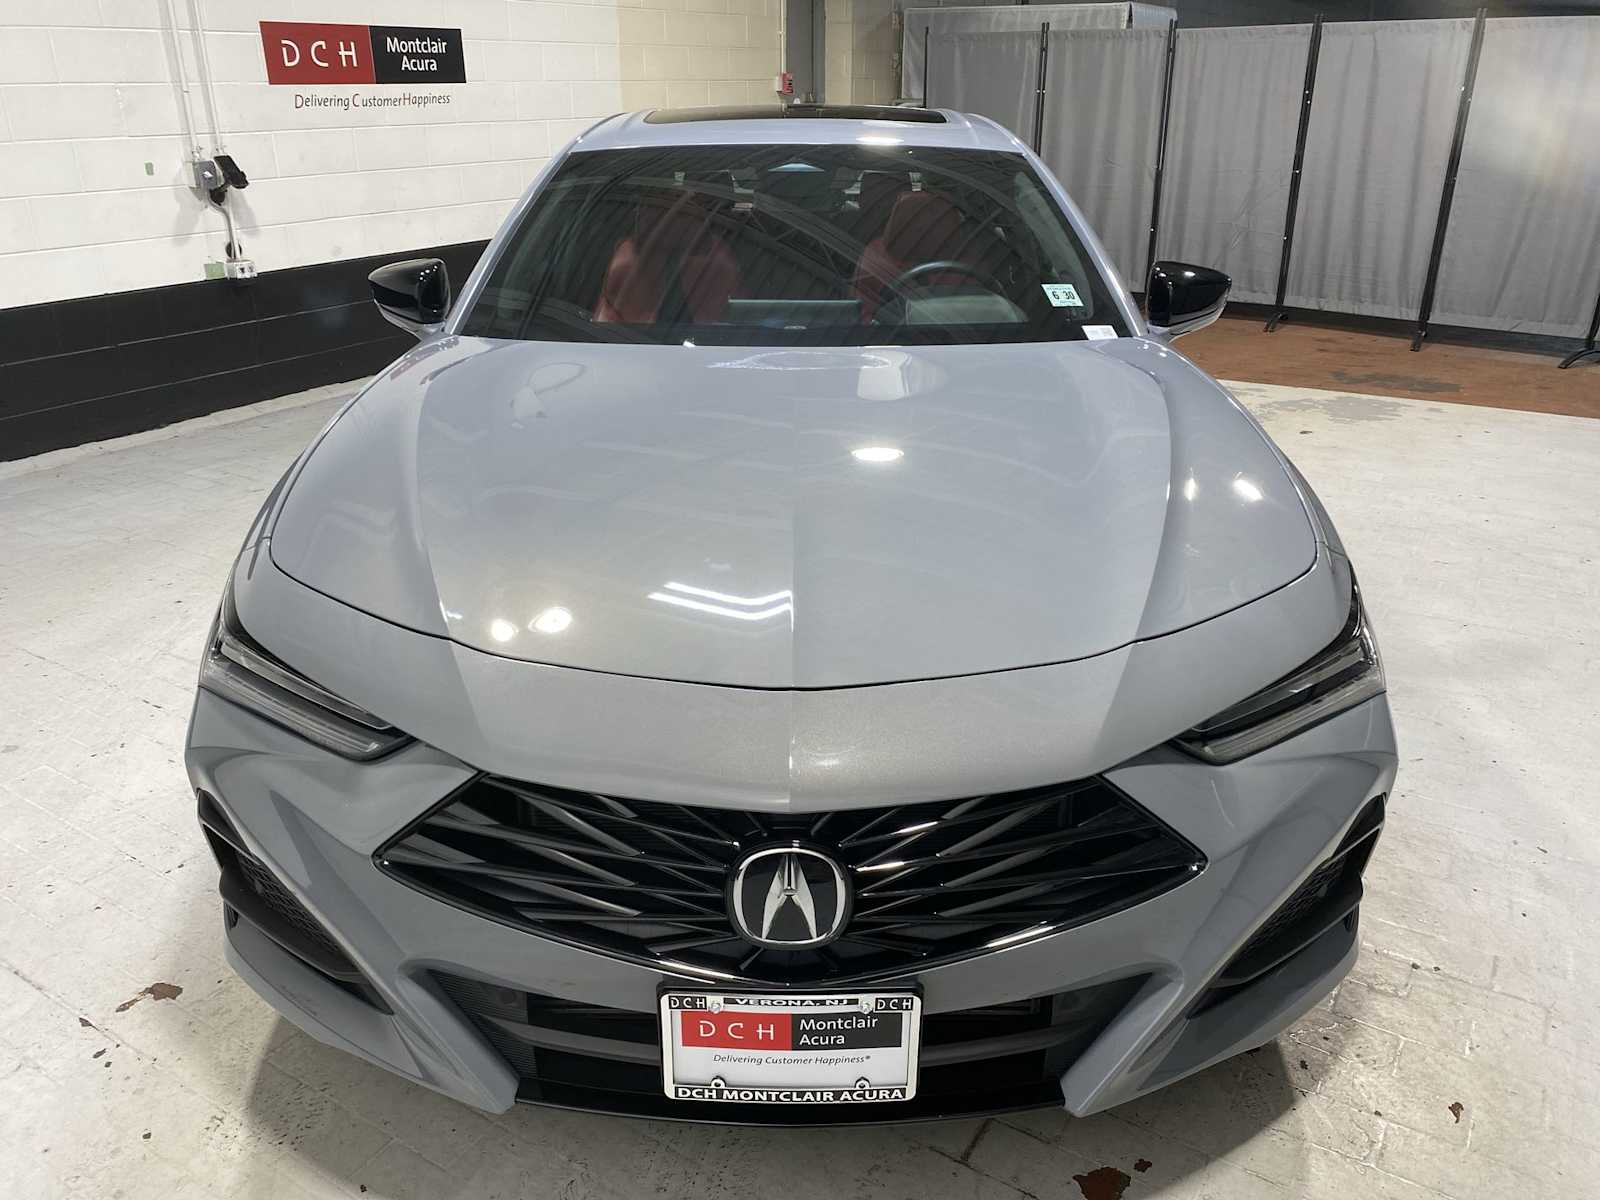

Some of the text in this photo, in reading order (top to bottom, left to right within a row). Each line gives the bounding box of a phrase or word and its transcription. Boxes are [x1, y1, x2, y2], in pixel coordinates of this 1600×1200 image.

[386, 36, 448, 54] Montclair
[281, 39, 358, 67] DCH
[401, 56, 438, 71] Acura
[294, 94, 350, 110] Delivering
[1051, 290, 1060, 300] 6
[670, 997, 706, 1009] DCH
[735, 998, 848, 1006] VERONA, NJ
[877, 998, 912, 1010] DCH
[699, 1020, 774, 1040] DCH
[799, 1015, 879, 1031] Montclair
[799, 1033, 845, 1046] Acura
[713, 1054, 763, 1065] Delivering
[765, 1055, 812, 1065] Customer
[678, 1087, 903, 1102] DCH MONTCLAIR ACURA
